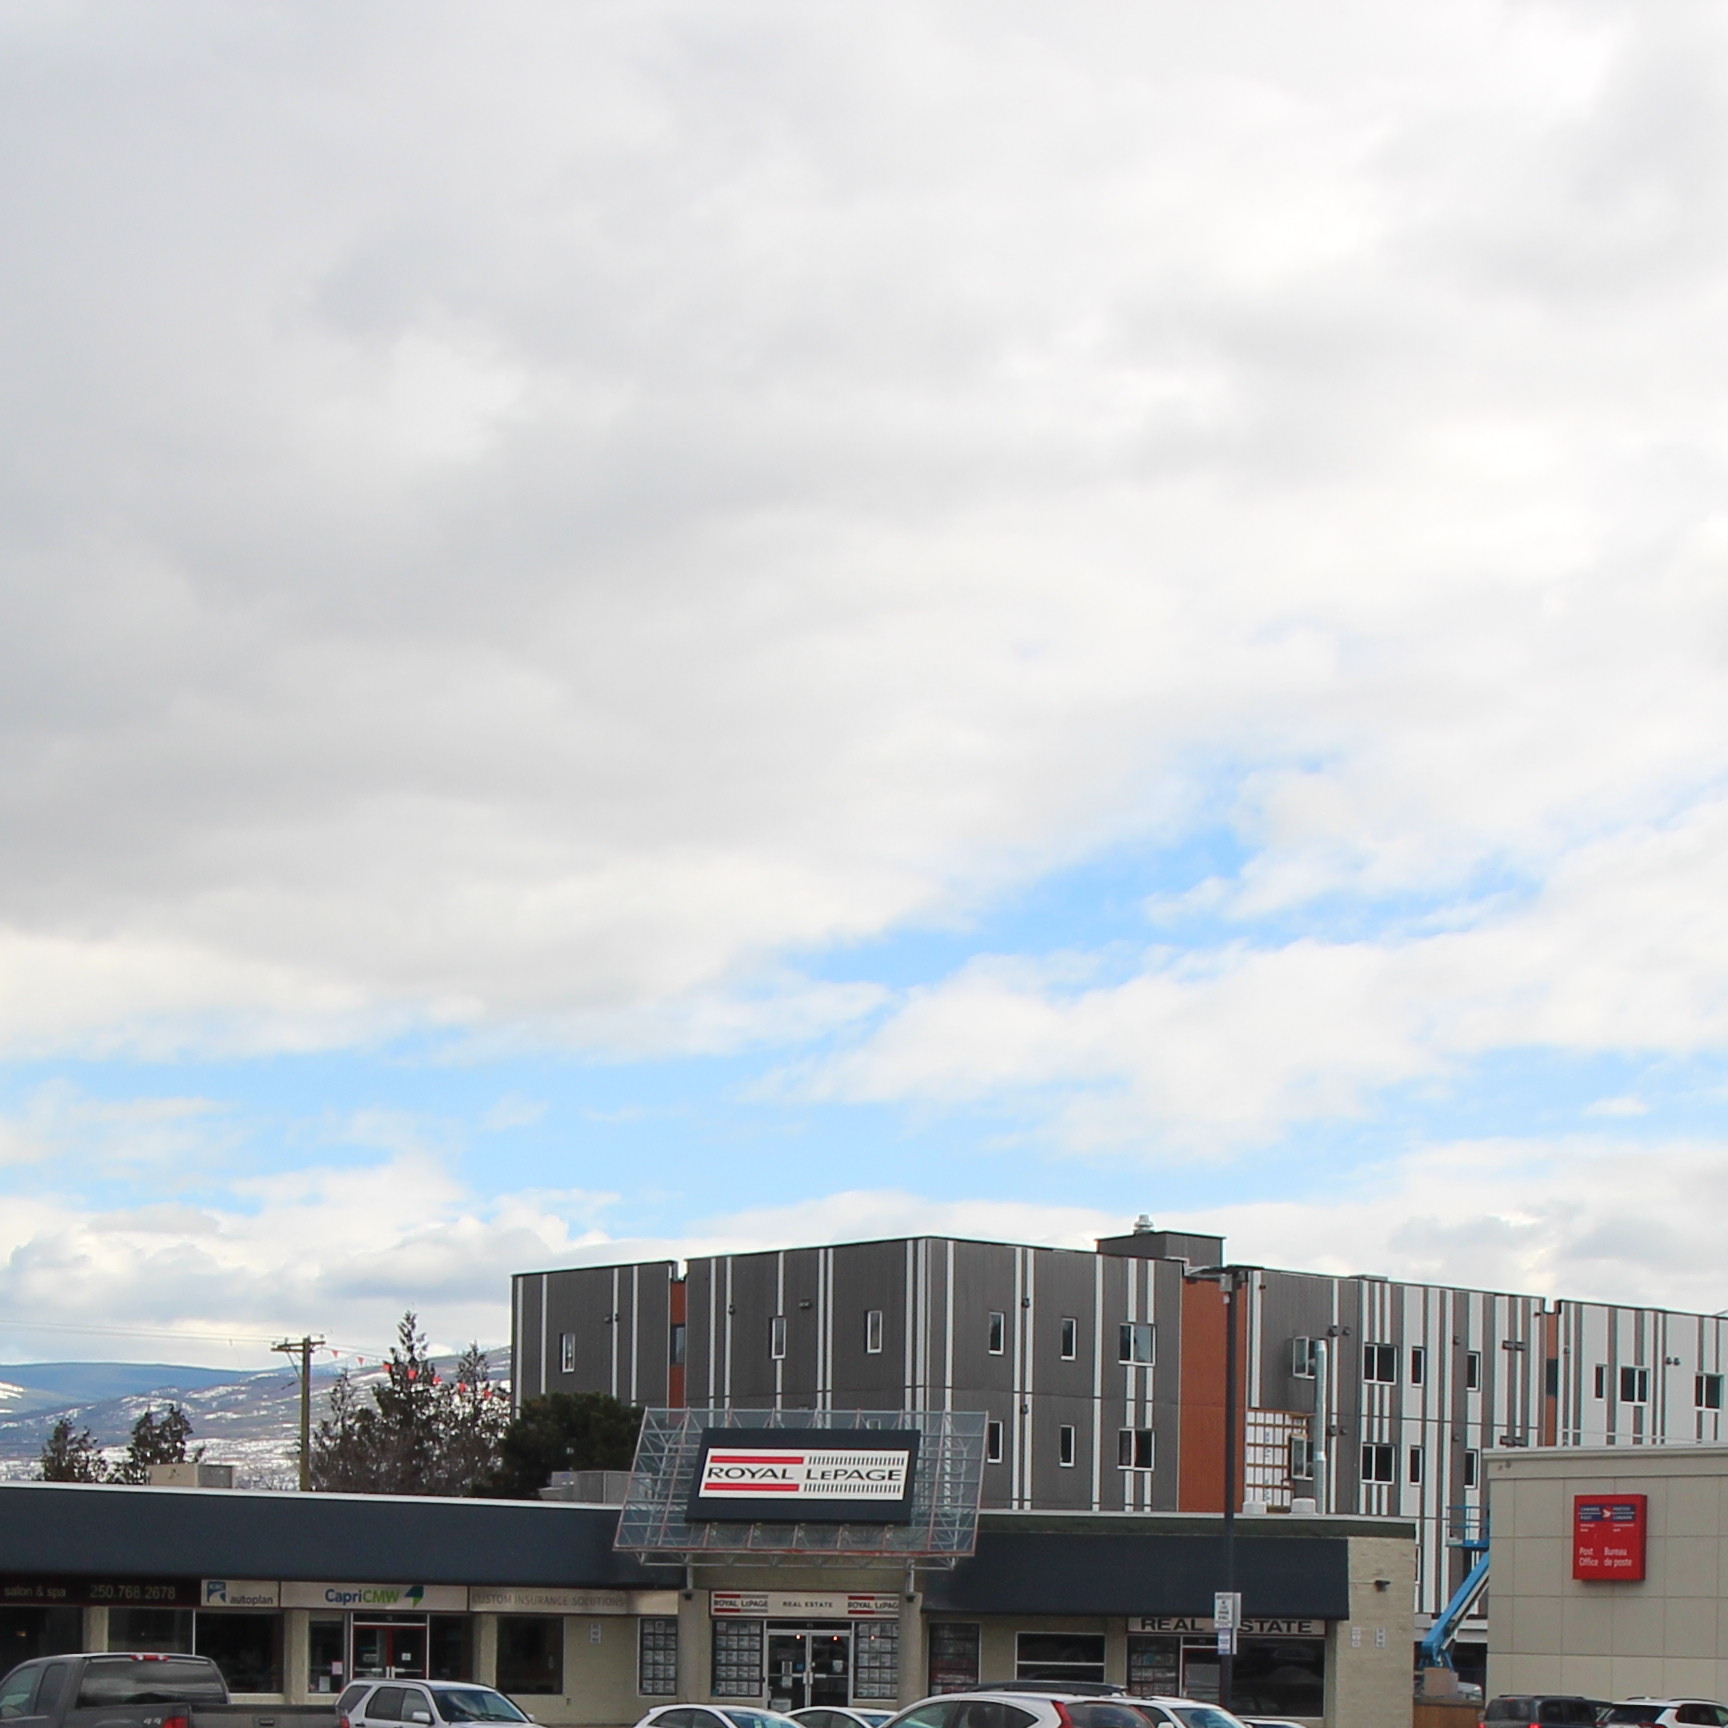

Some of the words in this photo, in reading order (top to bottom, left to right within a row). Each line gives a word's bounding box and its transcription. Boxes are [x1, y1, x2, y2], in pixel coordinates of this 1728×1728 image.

[707, 1466, 794, 1480] ROYAL
[1579, 1546, 1594, 1556] Post
[1604, 1546, 1628, 1556] Bureau
[1579, 1557, 1599, 1567] Office
[1604, 1557, 1613, 1567] de
[1614, 1558, 1633, 1569] poste
[4, 1586, 33, 1597] salon
[36, 1586, 44, 1597] &
[47, 1588, 67, 1600] spa
[90, 1584, 177, 1600] 250.768.2678
[325, 1588, 400, 1605] CapriCMW
[230, 1593, 273, 1606] autoplan
[514, 1594, 567, 1606] INSURANCE
[714, 1599, 738, 1608] ROYAL
[848, 1601, 871, 1609] ROYAL
[1141, 1617, 1204, 1632] REAL
[1237, 1619, 1313, 1634] STATE
